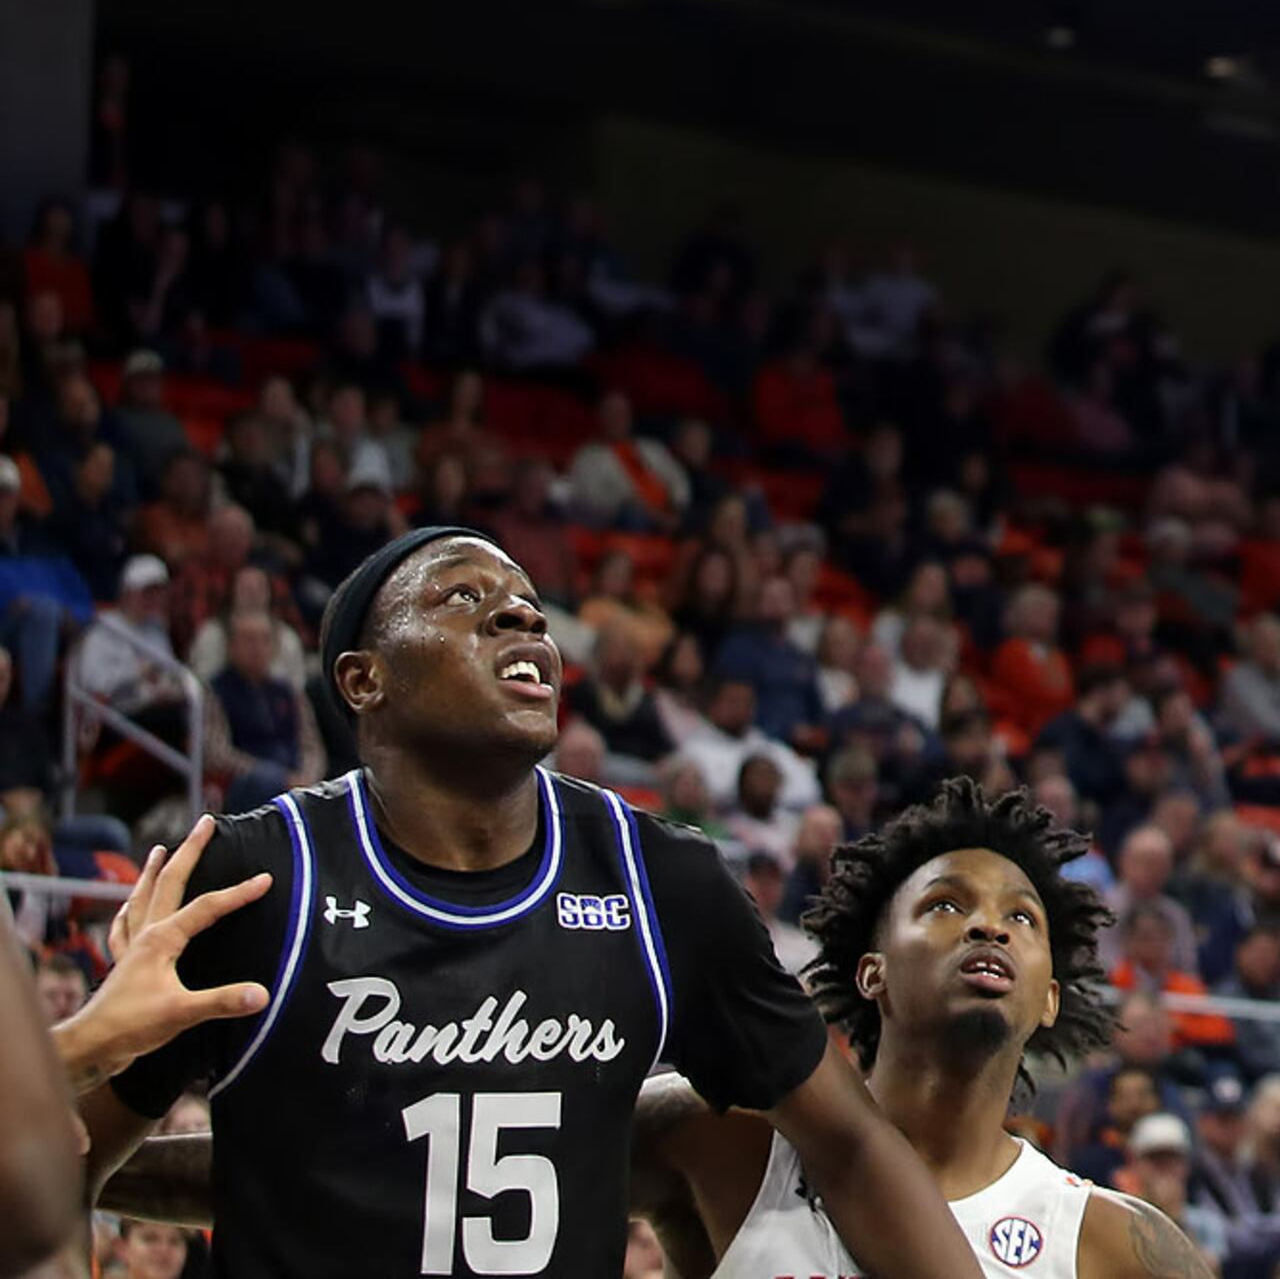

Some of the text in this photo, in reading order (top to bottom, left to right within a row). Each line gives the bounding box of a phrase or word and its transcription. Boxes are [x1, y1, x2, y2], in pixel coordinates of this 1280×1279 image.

[556, 892, 632, 930] SBC
[320, 976, 626, 1065] Panthers
[401, 1091, 563, 1277] 15
[990, 1218, 1042, 1267] SEC
